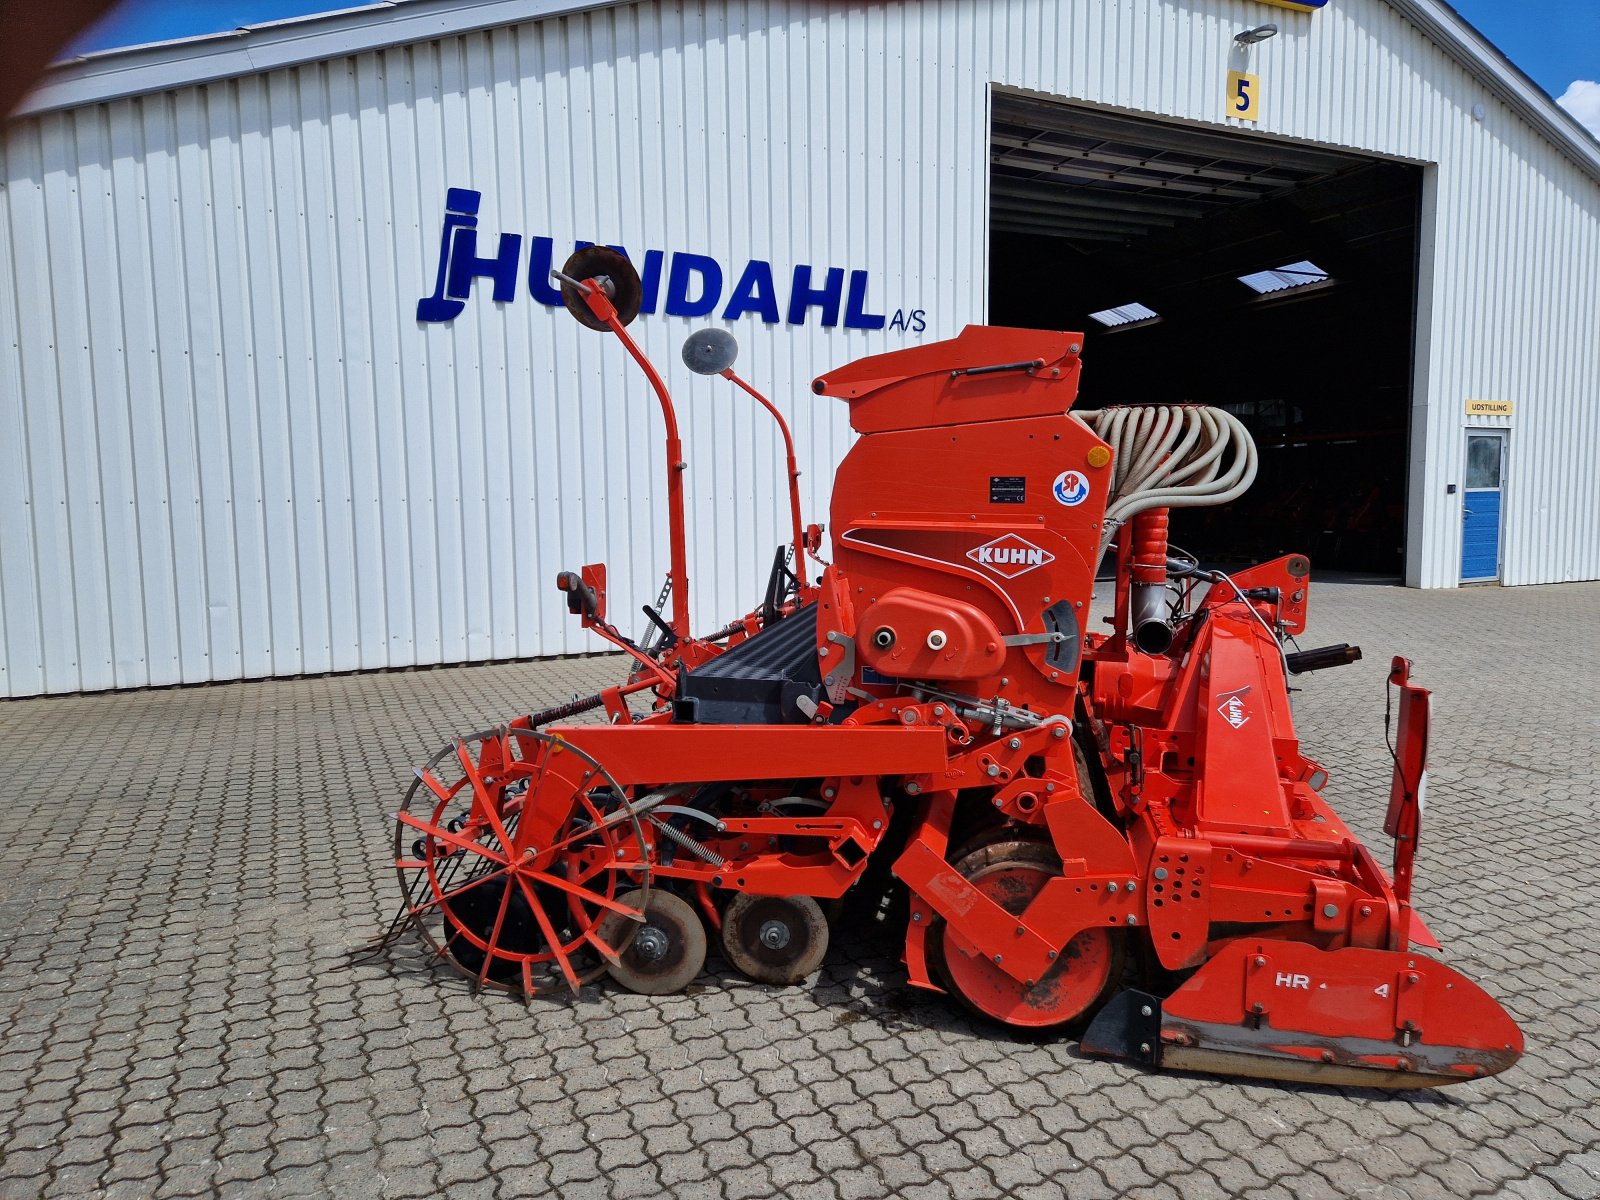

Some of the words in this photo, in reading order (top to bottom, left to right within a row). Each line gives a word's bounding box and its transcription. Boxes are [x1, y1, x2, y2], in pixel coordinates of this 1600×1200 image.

[1236, 79, 1249, 111] 5
[889, 308, 927, 332] A/S
[1471, 403, 1508, 411] UDSTILLING
[978, 547, 1043, 565] KUHN
[1275, 972, 1310, 990] HR
